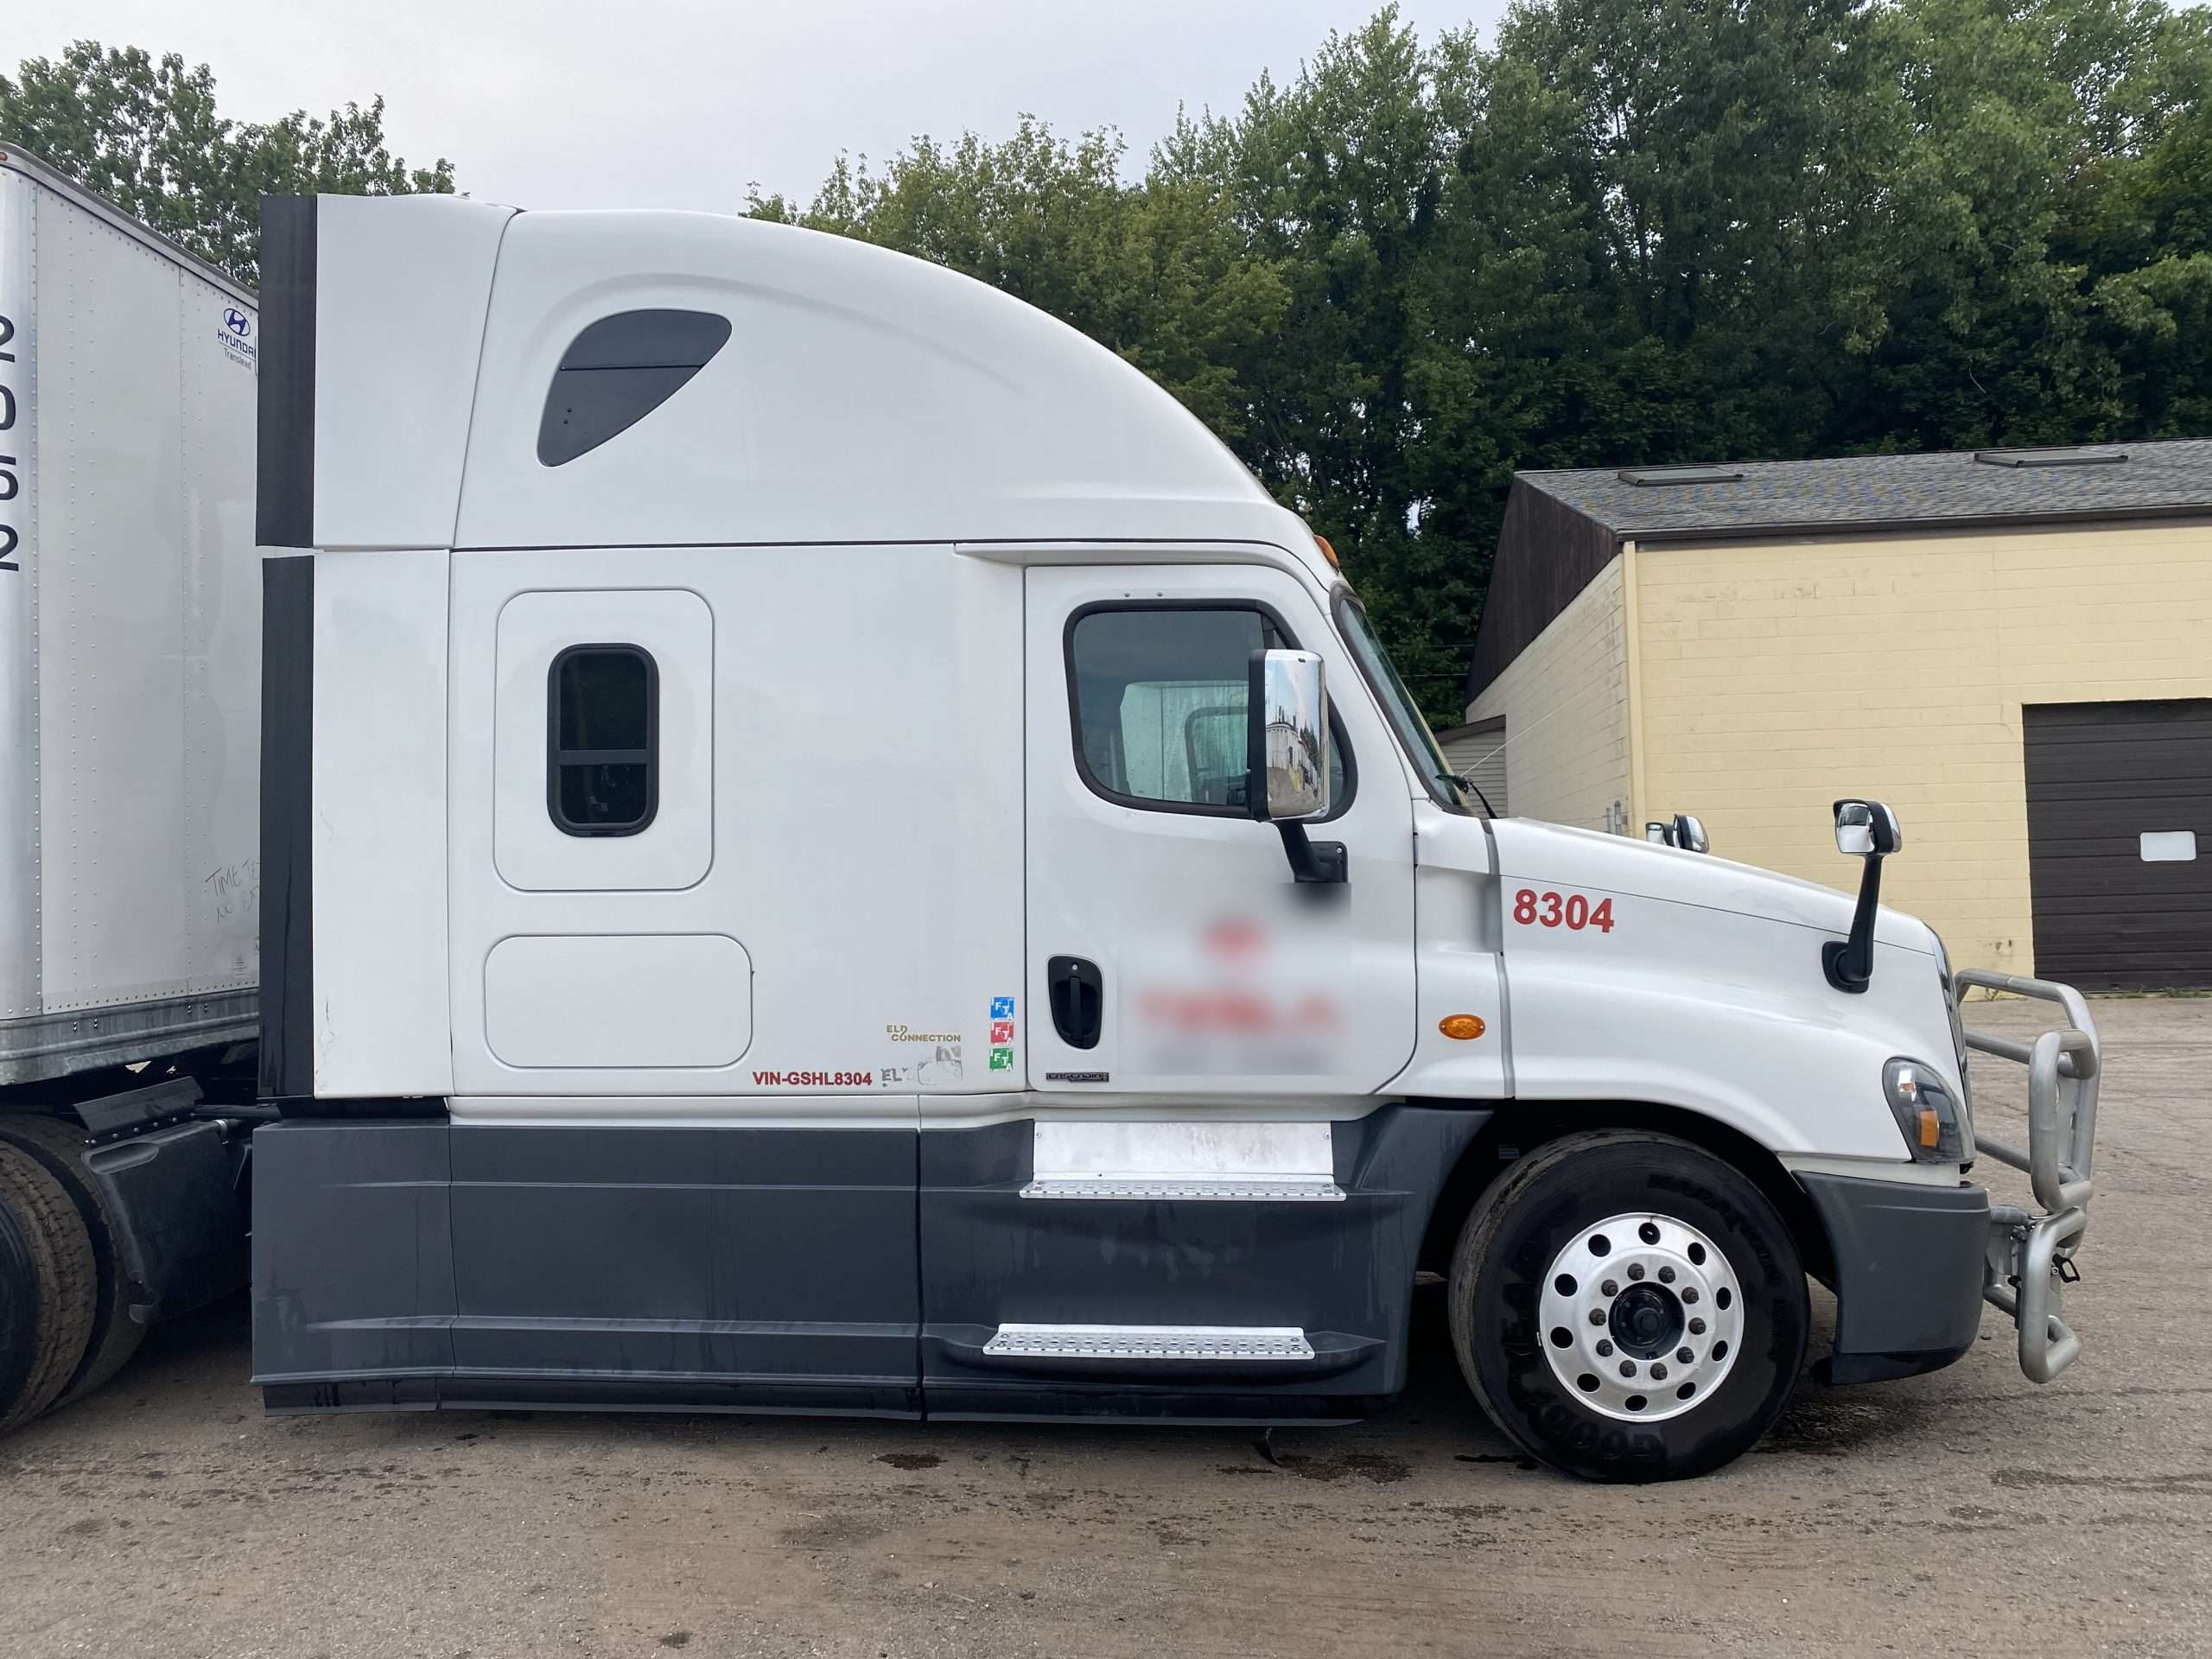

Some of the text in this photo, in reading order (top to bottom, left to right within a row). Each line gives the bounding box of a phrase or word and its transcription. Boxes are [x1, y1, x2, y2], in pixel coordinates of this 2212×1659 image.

[218, 328, 257, 359] HYUNDAI
[1513, 888, 1614, 933] 8304
[887, 1025, 908, 1034] ELD
[753, 1071, 873, 1086] VIN-GSHL8304
